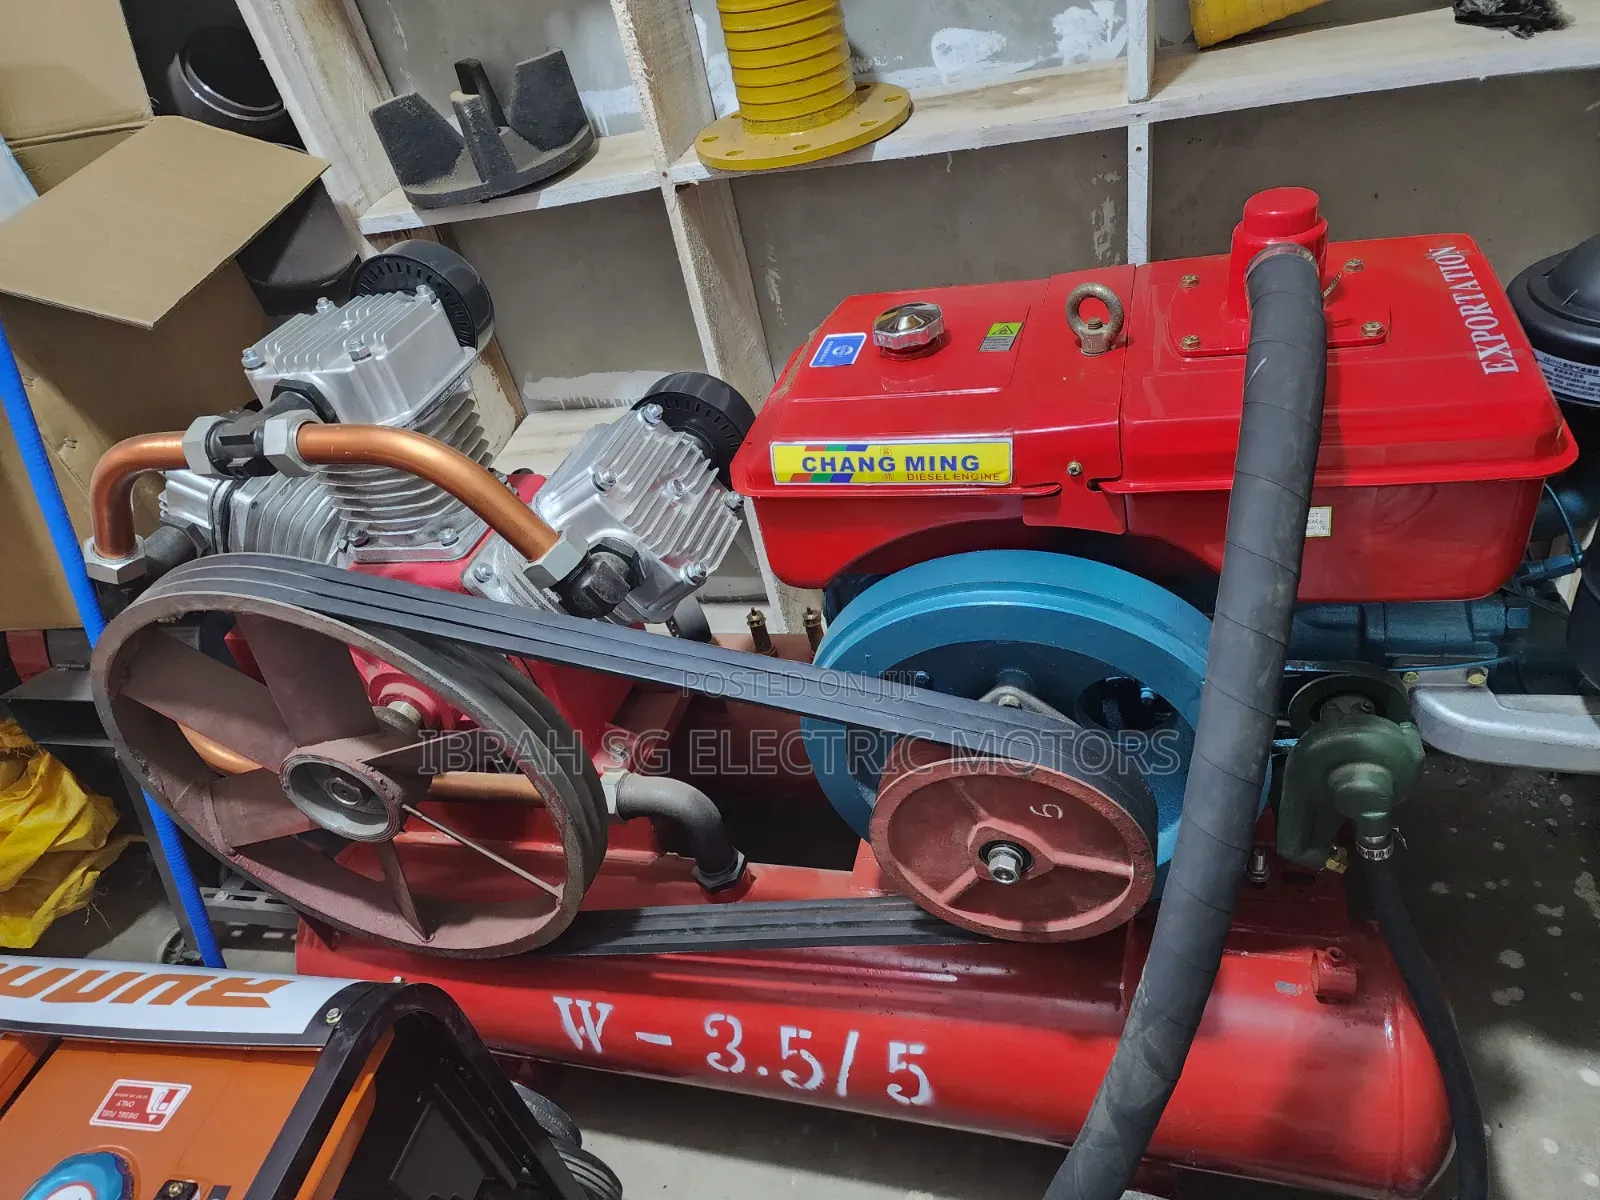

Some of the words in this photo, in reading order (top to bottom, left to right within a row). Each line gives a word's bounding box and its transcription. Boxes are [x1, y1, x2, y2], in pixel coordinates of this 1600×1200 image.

[1429, 246, 1519, 375] EXPORTATION
[801, 456, 896, 473] CHANG
[905, 455, 980, 472] MING
[907, 473, 950, 481] DIESEL
[953, 473, 1000, 481] ENGINE
[552, 996, 614, 1053] W
[115, 1099, 136, 1108] ONLY
[101, 1109, 117, 1118] FUEL
[117, 1110, 140, 1120] DIESEL
